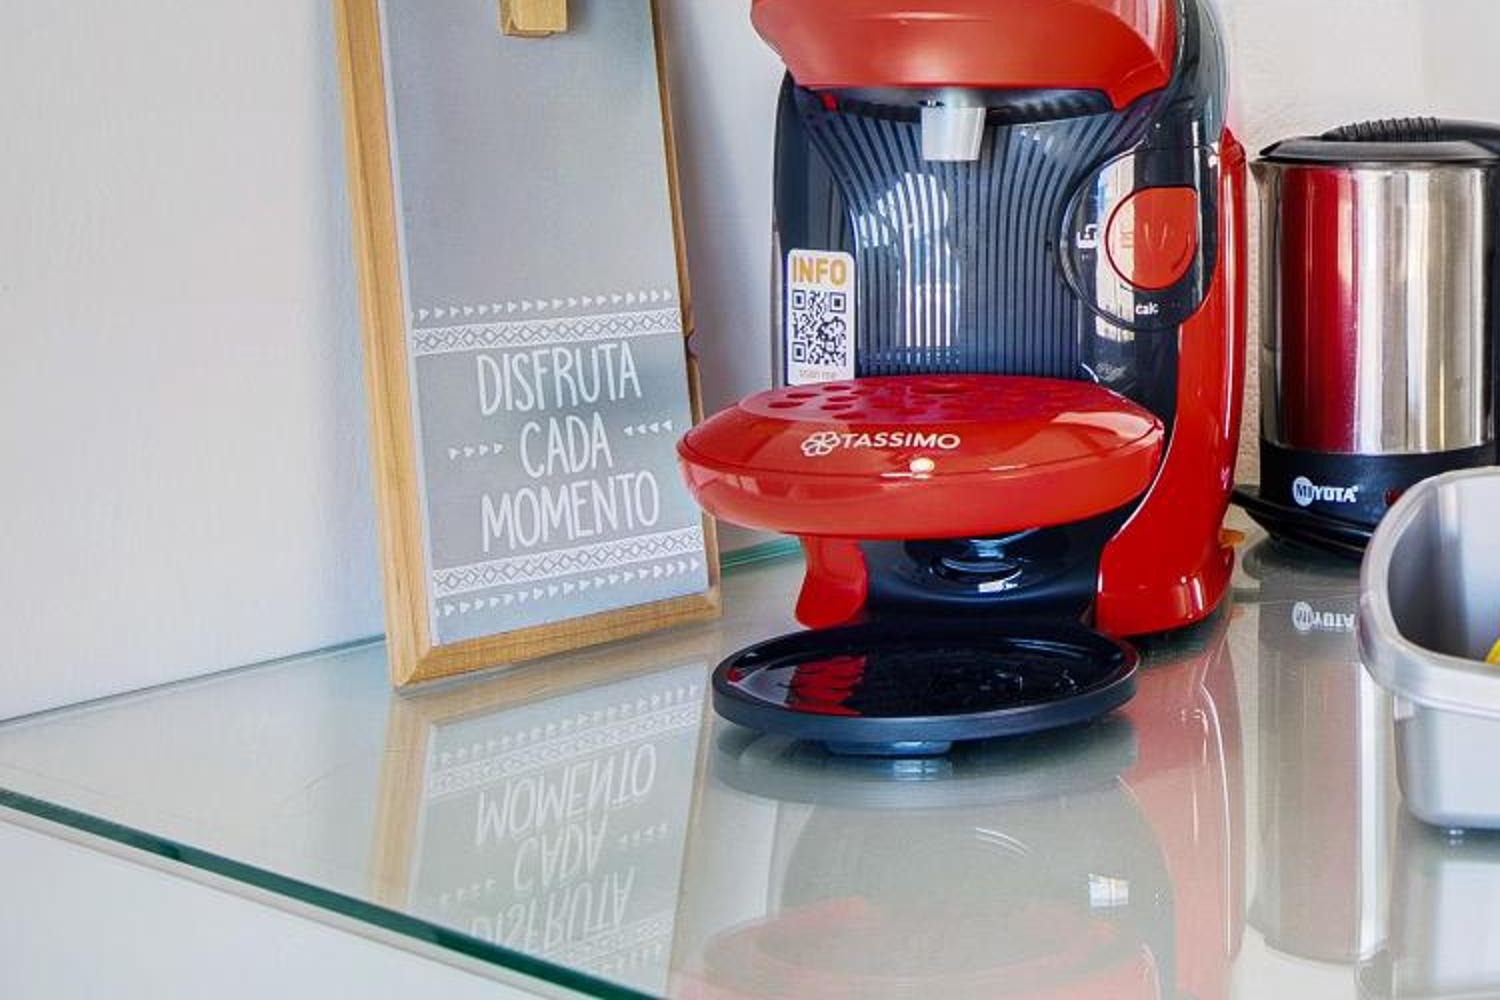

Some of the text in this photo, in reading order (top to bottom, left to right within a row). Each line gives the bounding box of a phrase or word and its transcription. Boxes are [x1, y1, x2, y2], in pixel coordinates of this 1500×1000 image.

[792, 256, 847, 286] INFO
[477, 341, 642, 415] DISFRUTA
[518, 412, 614, 479] CADA
[838, 431, 961, 450] TASSIMO
[481, 470, 661, 553] MOMENTO
